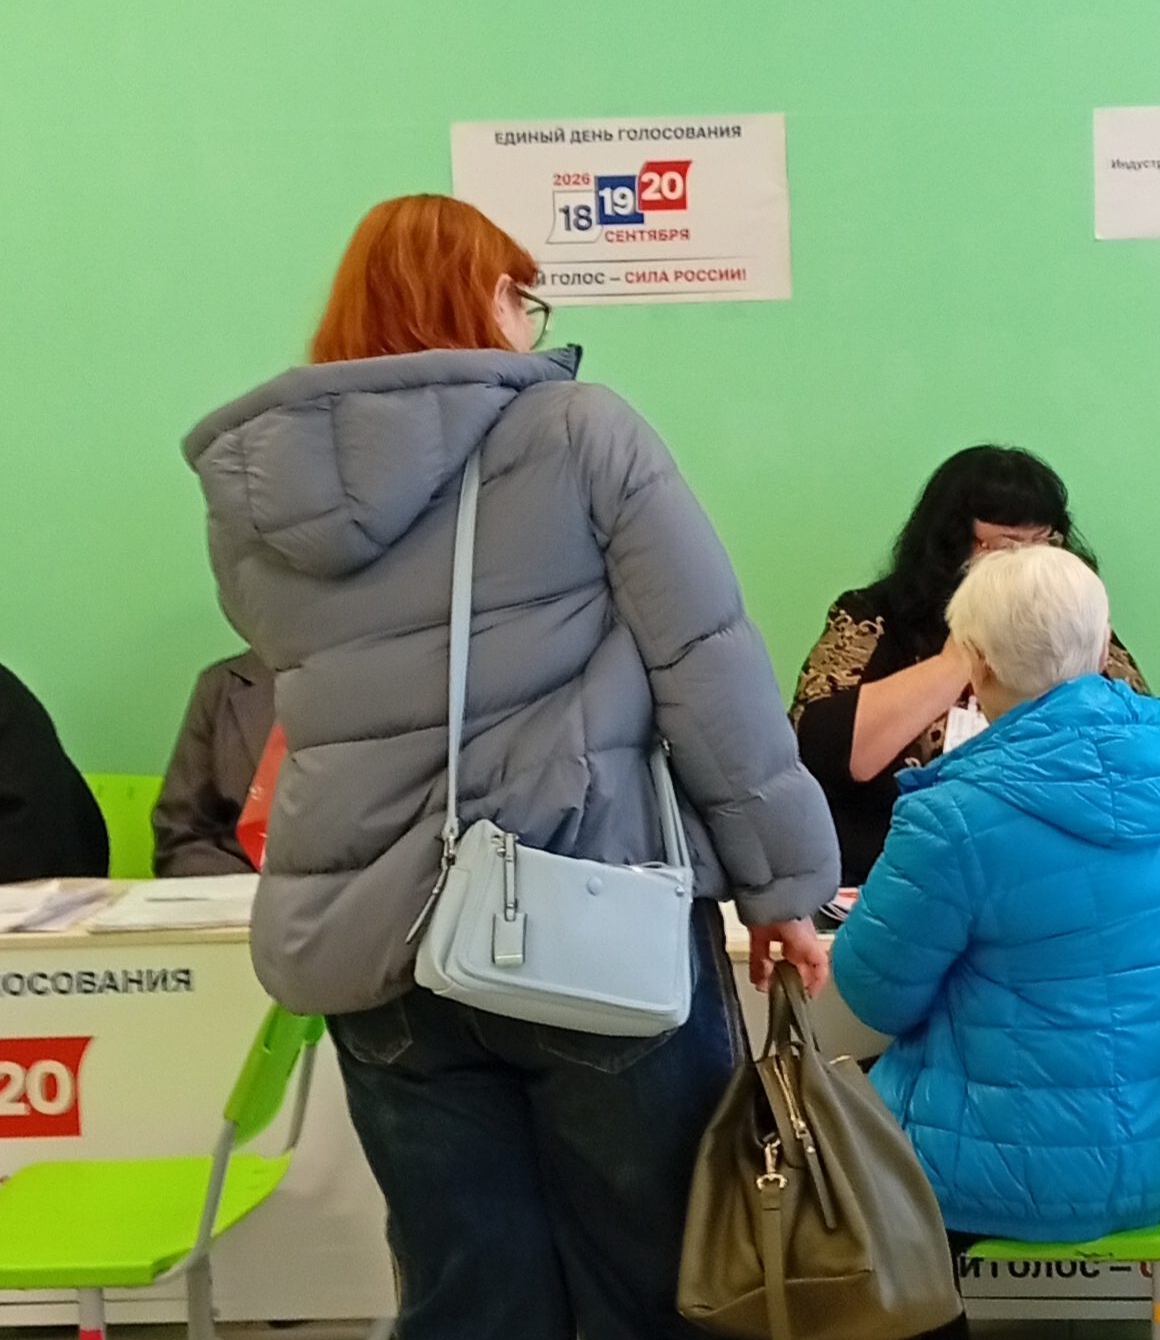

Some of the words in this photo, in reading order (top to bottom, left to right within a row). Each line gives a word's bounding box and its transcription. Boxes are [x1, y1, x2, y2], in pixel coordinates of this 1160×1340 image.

[495, 127, 565, 146] ЕДИНЫЙ
[570, 129, 613, 144] ДЕНЬ
[618, 125, 742, 141] ГОЛОСОВАНИЯ
[553, 173, 590, 187] 2026
[559, 204, 592, 231] 18
[599, 186, 636, 216] 19
[641, 171, 684, 200] 20
[604, 228, 690, 243] СЕНТЯБРЯ
[551, 271, 605, 286] ГОЛОС
[624, 269, 668, 284] СИЛА
[674, 267, 746, 283] РОССИИ!
[0, 968, 194, 997] ОСОВАНИЯ
[0, 1059, 74, 1116] 20
